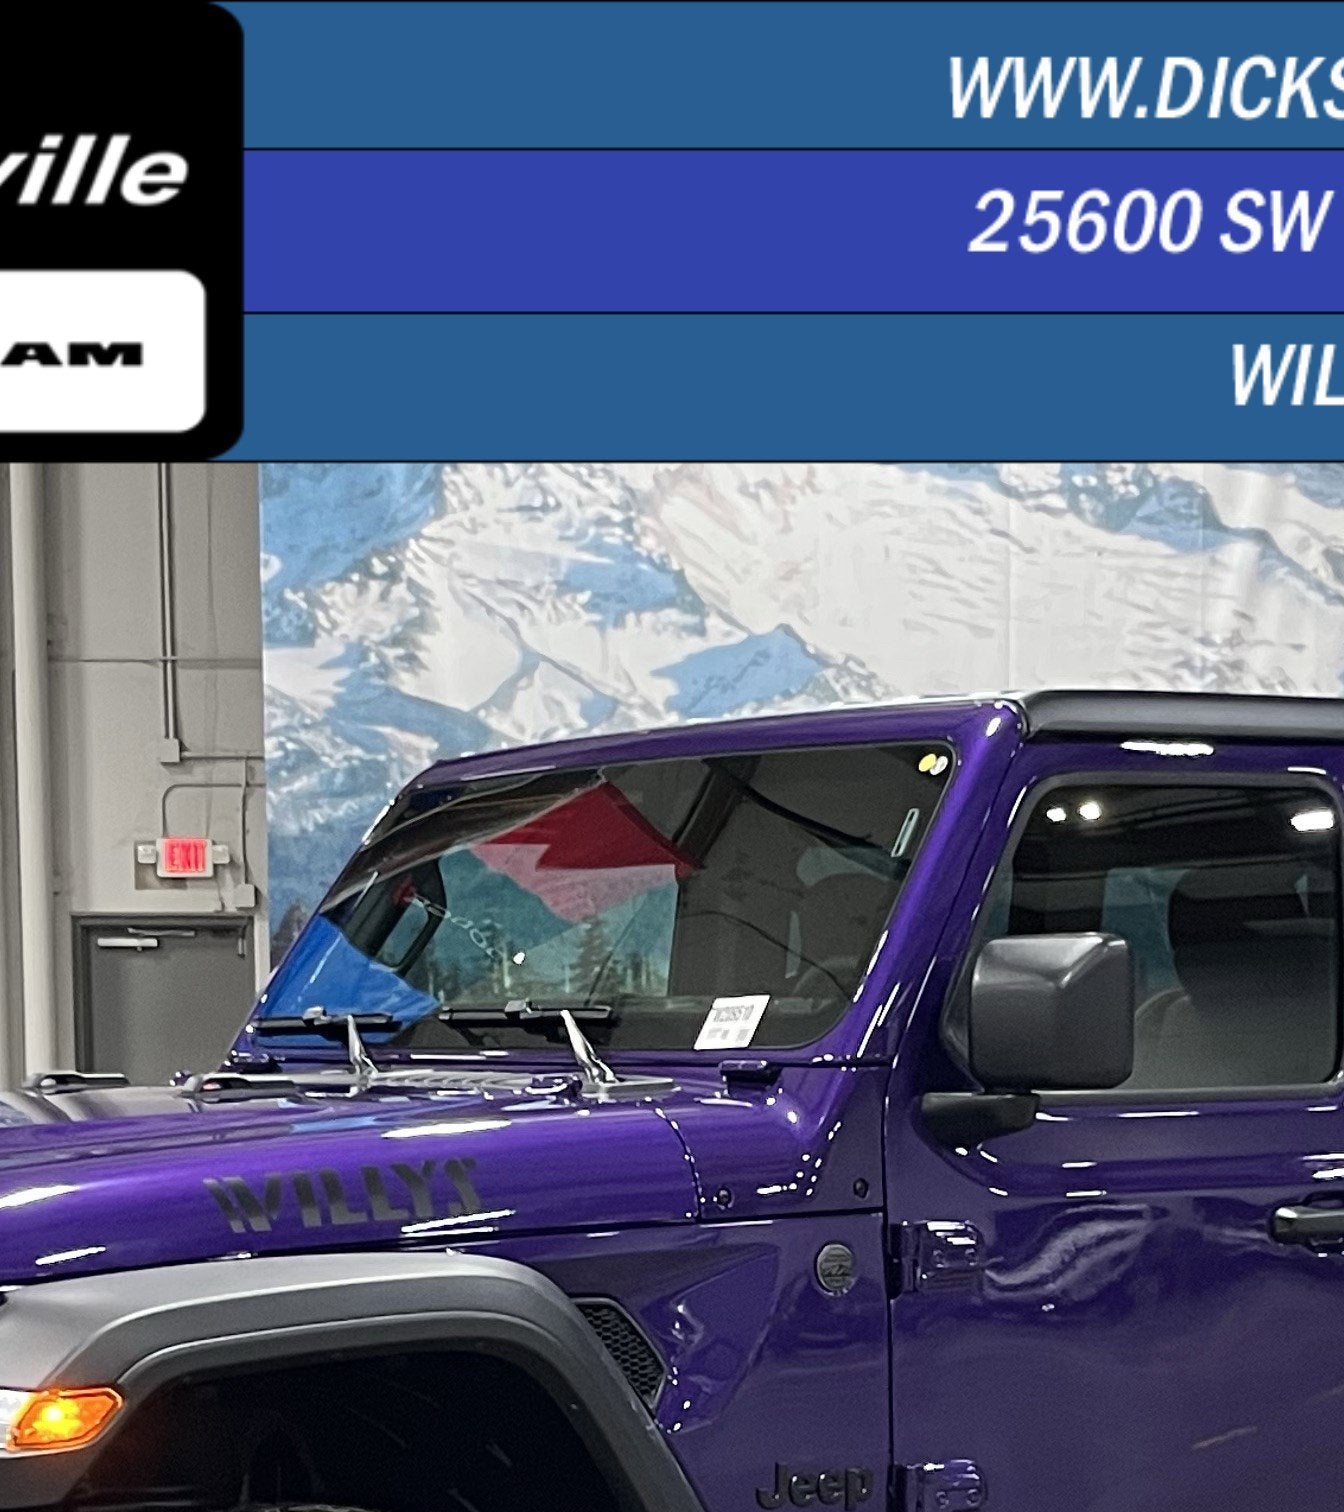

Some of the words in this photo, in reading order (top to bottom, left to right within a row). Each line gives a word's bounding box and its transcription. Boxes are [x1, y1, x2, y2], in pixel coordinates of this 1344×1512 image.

[166, 841, 206, 873] EXIT
[203, 1156, 482, 1234] WILLYS
[755, 1461, 874, 1512] Jeep
